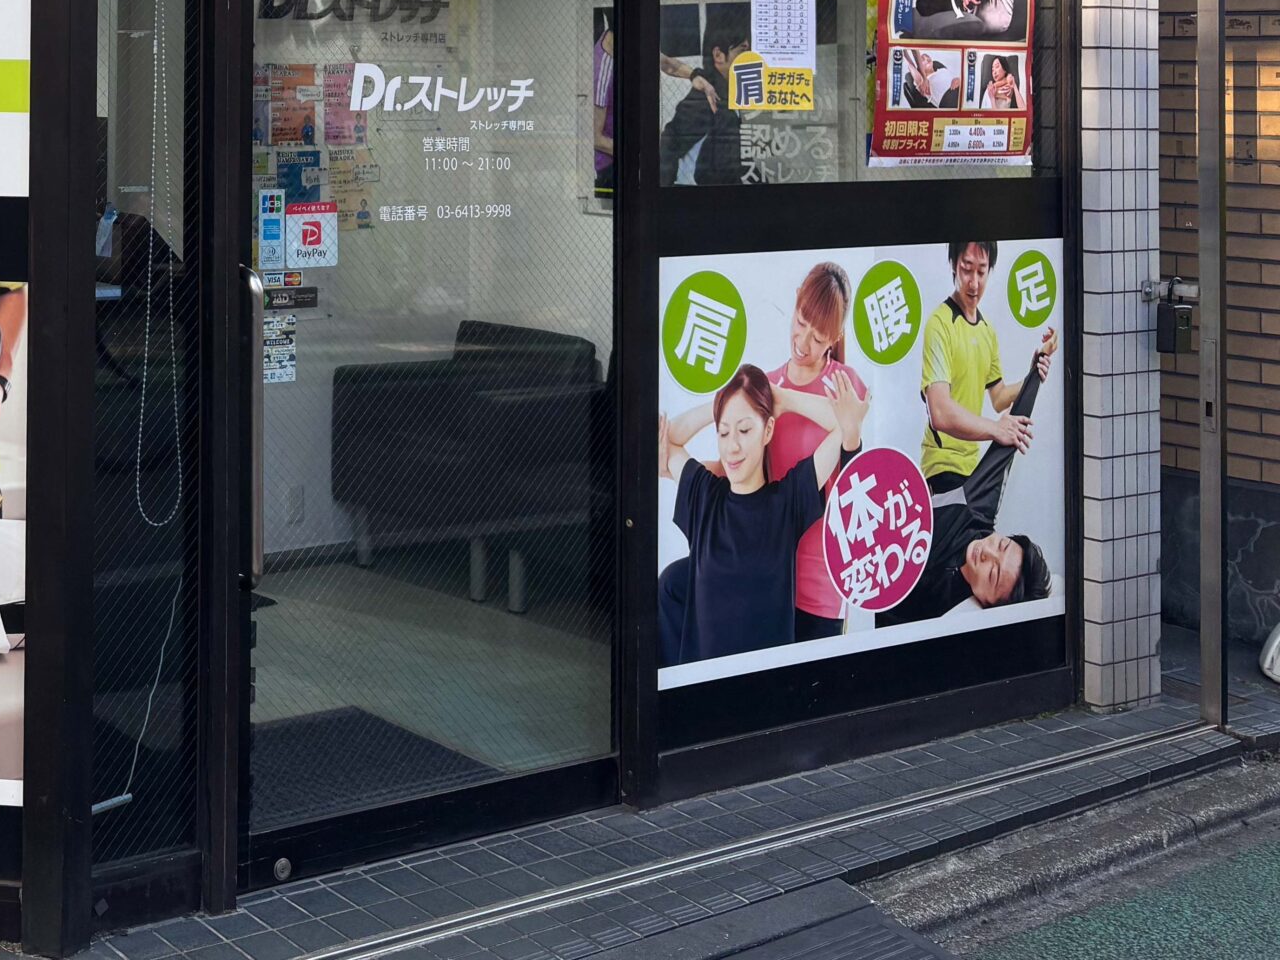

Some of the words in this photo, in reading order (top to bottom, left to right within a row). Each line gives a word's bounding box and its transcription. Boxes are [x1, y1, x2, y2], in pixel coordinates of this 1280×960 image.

[350, 63, 534, 112] Dr.ストレッチ
[733, 61, 764, 107] 肩
[767, 90, 811, 105] あなたへ
[470, 120, 535, 131] ストレッチ専門店
[884, 121, 930, 137] 初回限定
[422, 137, 470, 152] 営業時間
[379, 205, 429, 221] 電話番号
[436, 204, 512, 219] 03-6413-9998
[296, 248, 327, 259] PayPay
[1015, 261, 1051, 318] 足
[863, 276, 912, 354] 腰
[675, 290, 737, 375] 肩
[839, 518, 931, 608] 変わる
